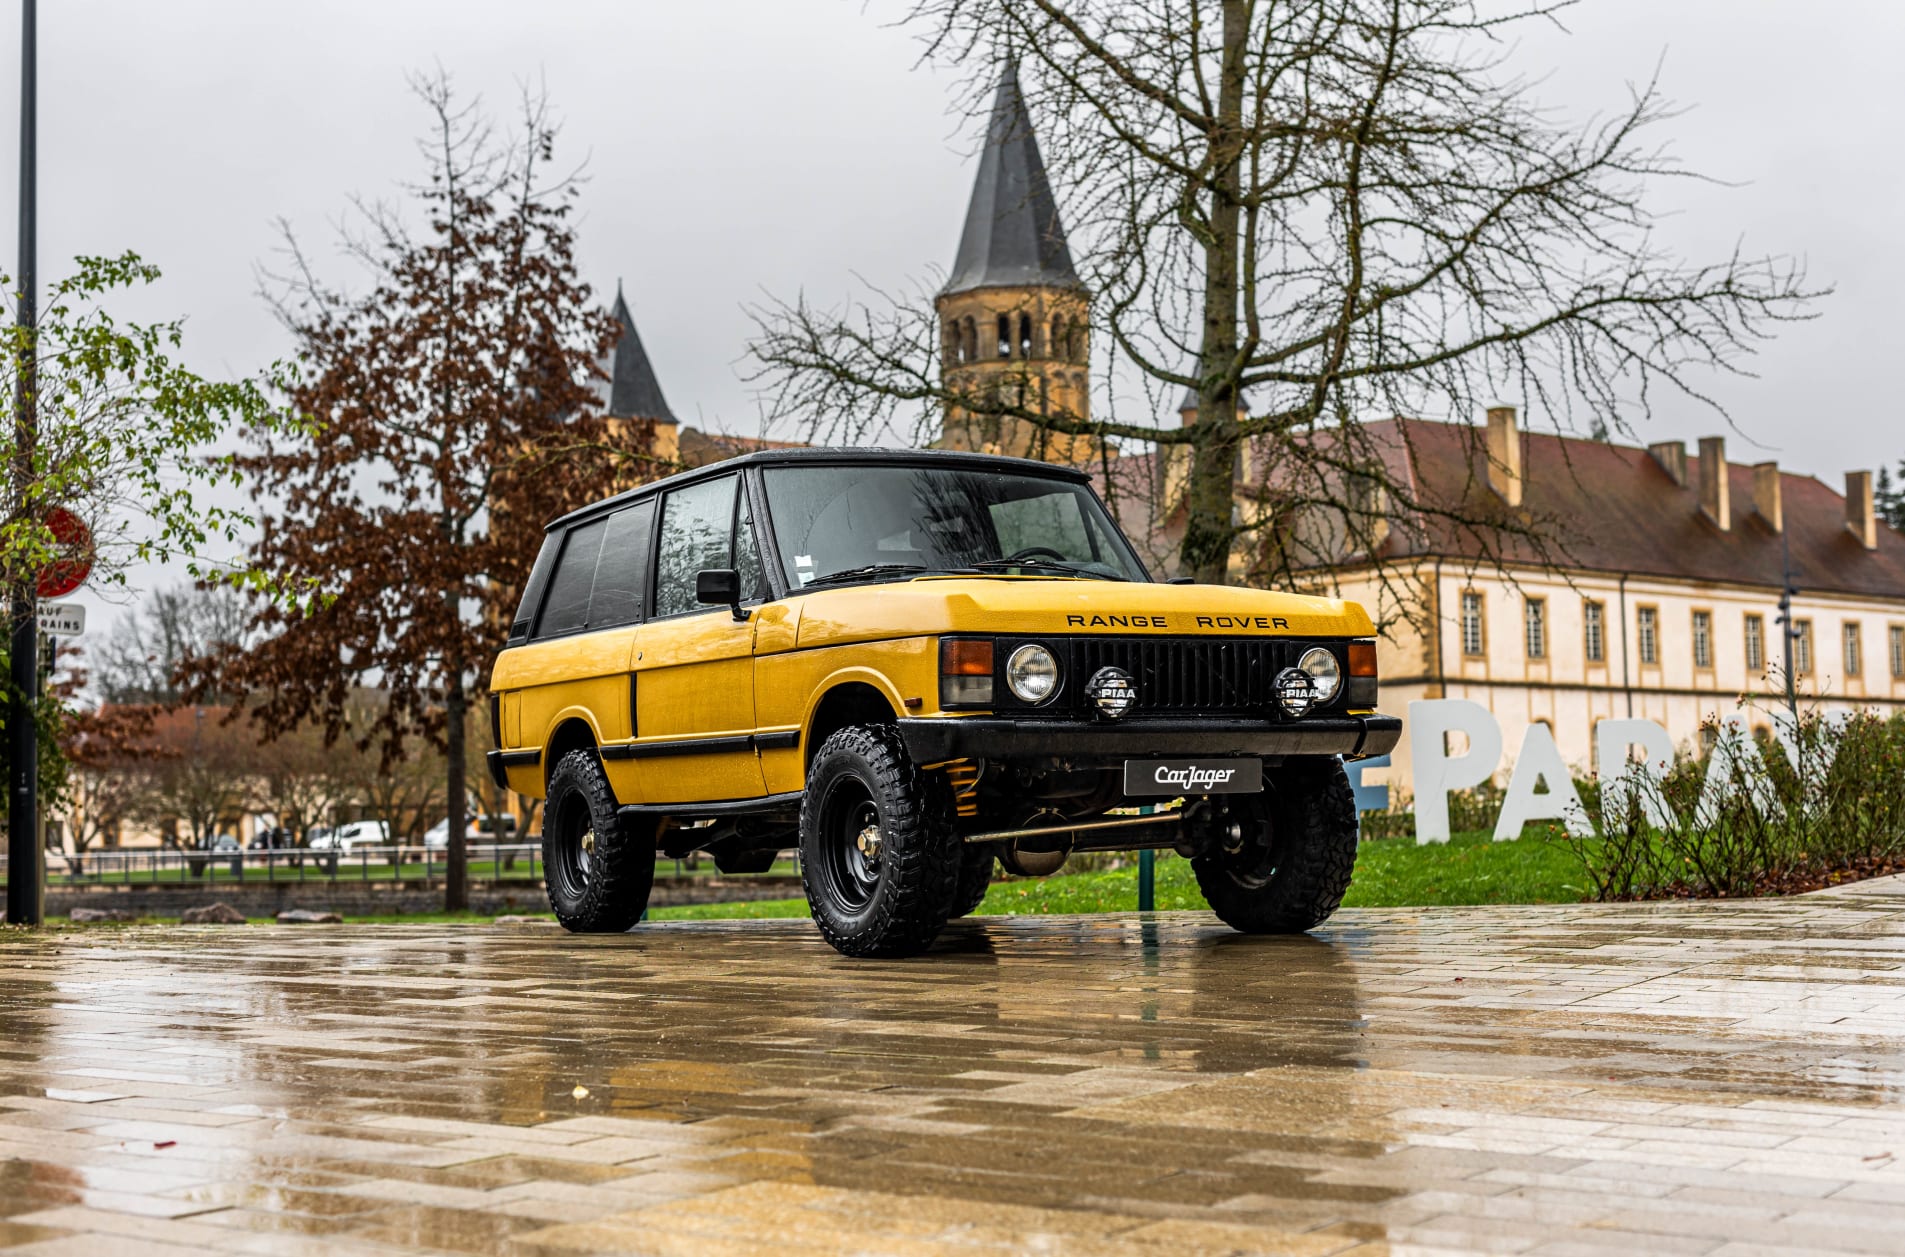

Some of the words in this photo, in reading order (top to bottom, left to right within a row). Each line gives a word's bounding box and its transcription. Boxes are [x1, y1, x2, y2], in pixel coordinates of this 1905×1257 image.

[38, 605, 63, 617] AUF
[40, 619, 80, 631] RAINS
[1066, 614, 1168, 628] RANGE
[1196, 616, 1290, 630] ROVER
[1101, 688, 1136, 698] PIAA
[1286, 688, 1317, 698] PIAA
